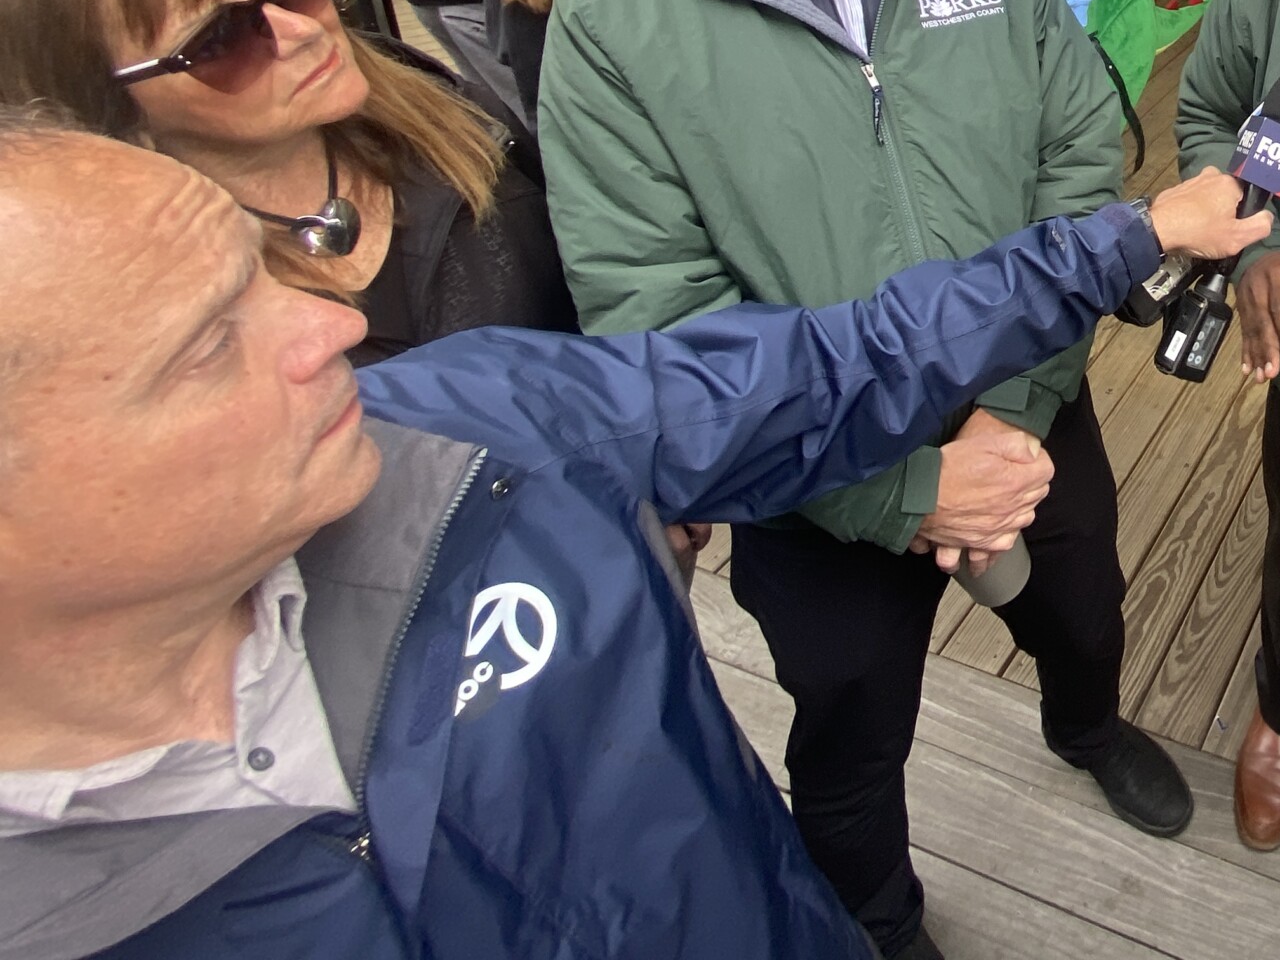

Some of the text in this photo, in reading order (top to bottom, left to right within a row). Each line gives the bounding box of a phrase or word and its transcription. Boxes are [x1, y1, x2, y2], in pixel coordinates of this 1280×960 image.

[921, 6, 1005, 29] WESTCHESTER COUNTY
[1253, 152, 1274, 166] NEW
